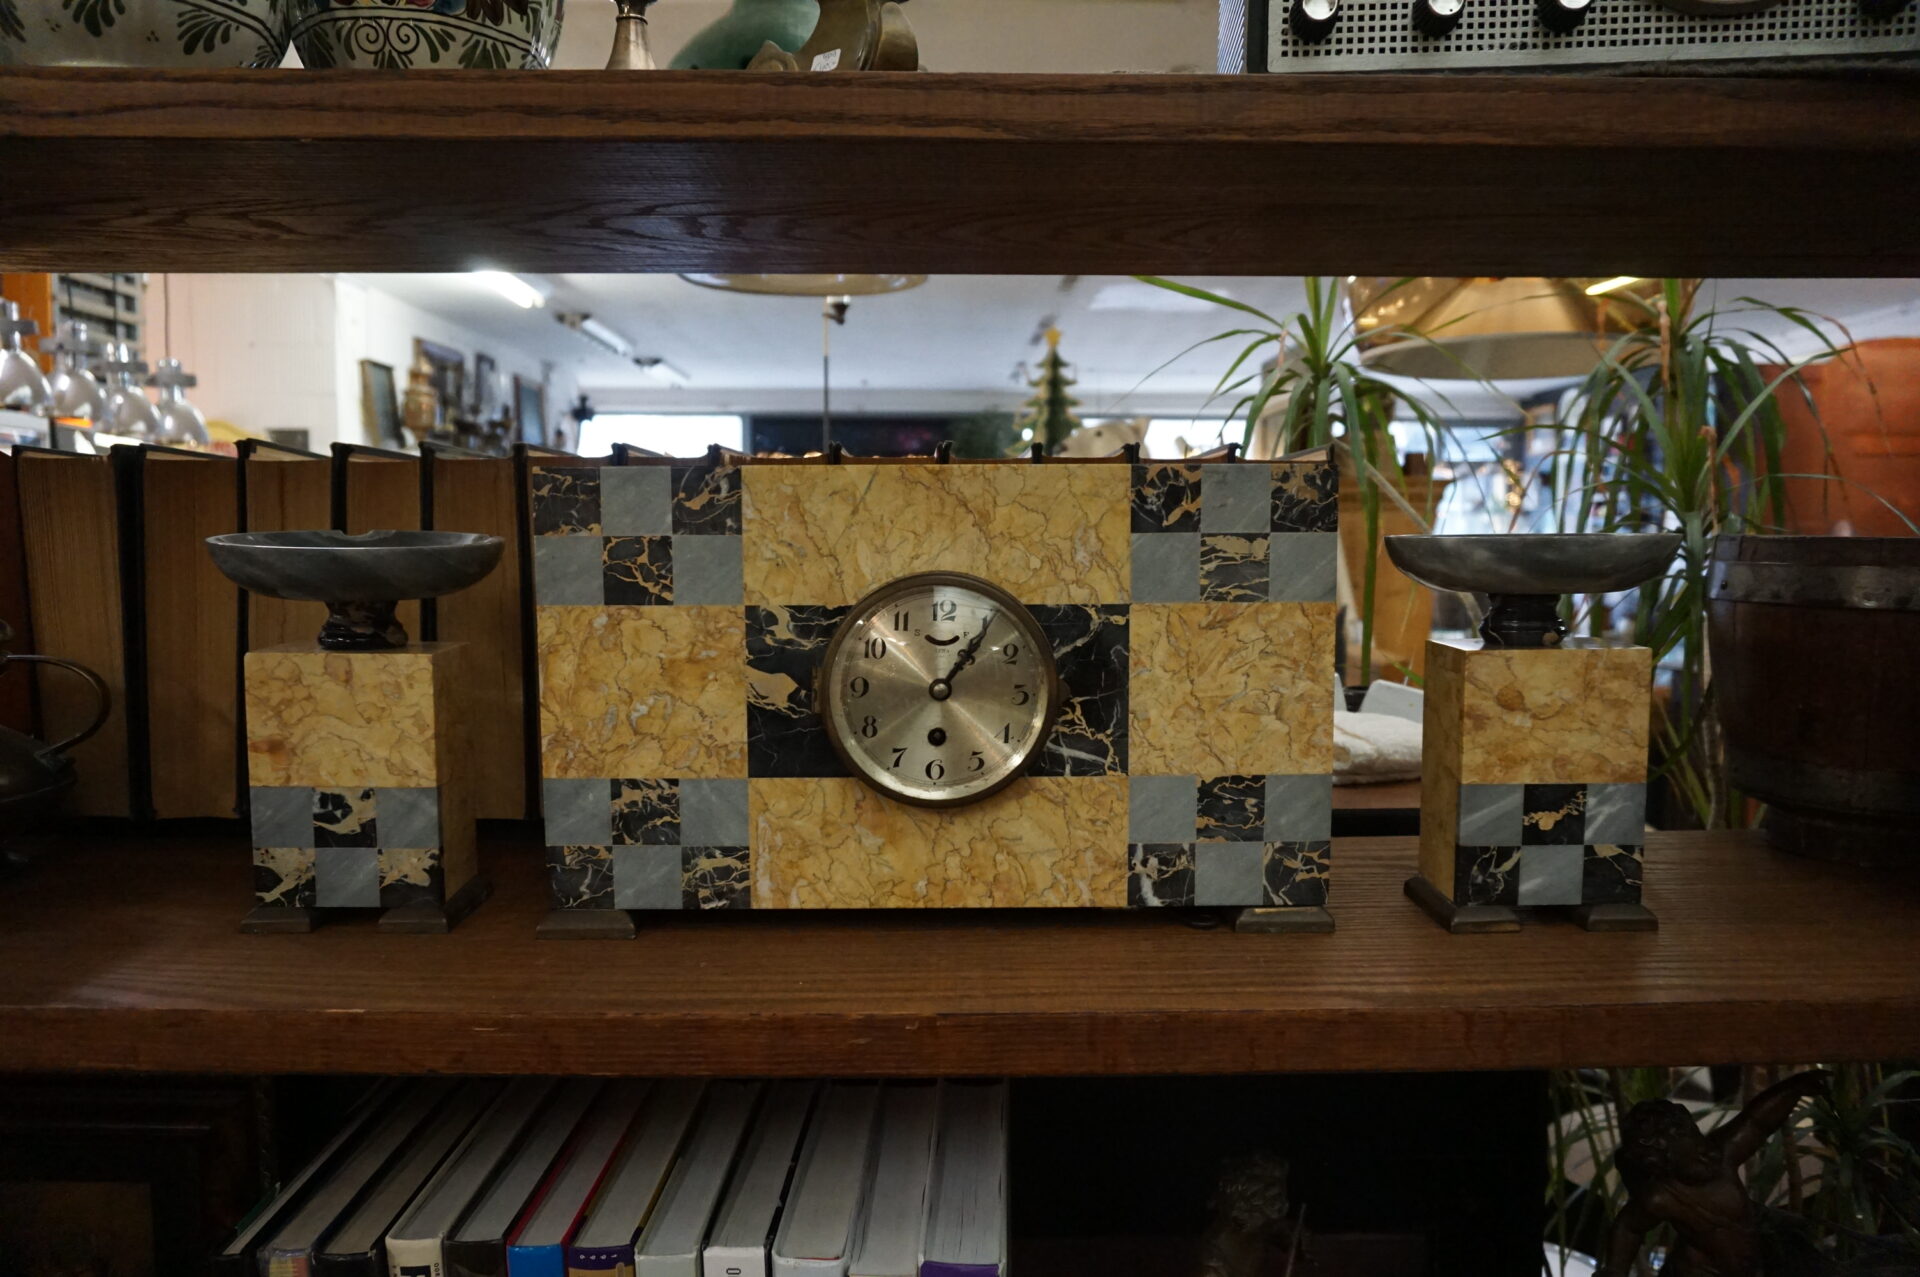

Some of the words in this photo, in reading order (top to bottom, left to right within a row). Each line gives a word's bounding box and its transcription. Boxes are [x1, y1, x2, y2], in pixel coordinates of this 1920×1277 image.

[893, 610, 909, 631] 11
[932, 599, 957, 621] 12
[863, 637, 886, 660] 10
[1002, 643, 1019, 665] 2
[850, 676, 869, 698] 9
[1011, 684, 1029, 706] 3
[861, 715, 878, 738] 8
[994, 723, 1014, 744] 4
[892, 747, 908, 768] 7
[967, 751, 985, 772] 5
[925, 759, 945, 780] 6
